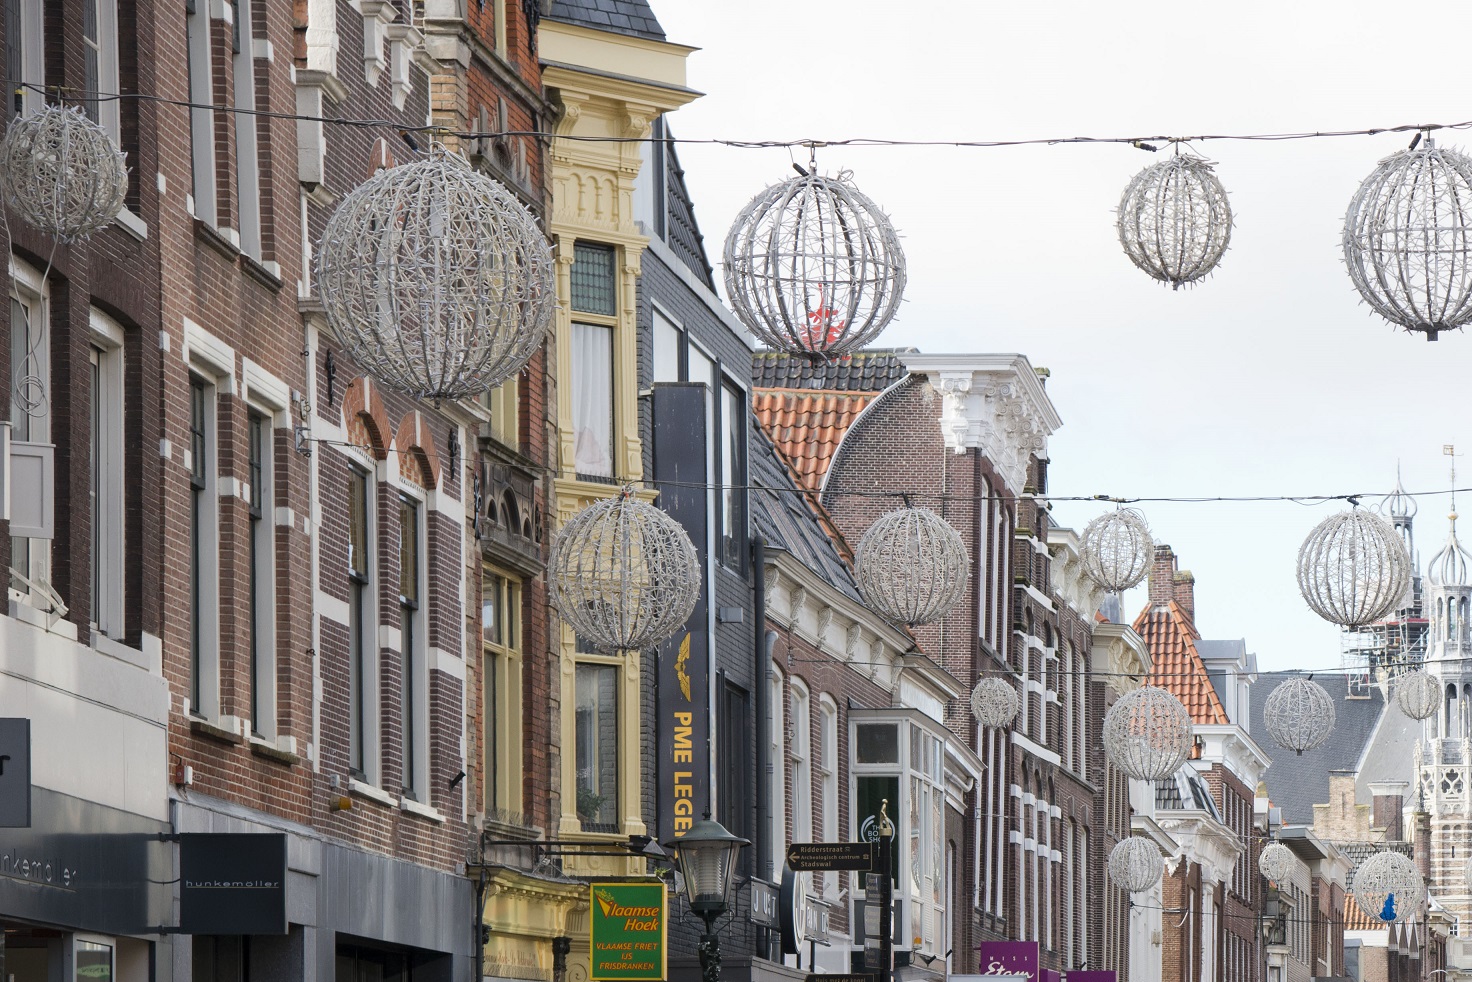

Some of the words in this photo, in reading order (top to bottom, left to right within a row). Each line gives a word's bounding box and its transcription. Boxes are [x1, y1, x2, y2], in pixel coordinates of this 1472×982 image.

[673, 711, 693, 764] PME
[185, 879, 279, 887] hunkemöller
[624, 918, 660, 931] Hoek
[596, 942, 632, 951] VLAAMSE
[634, 942, 658, 951] FRIET
[621, 952, 633, 960] IJS
[599, 962, 655, 970] FRISDRANKEN
[984, 961, 1035, 979] Etam
